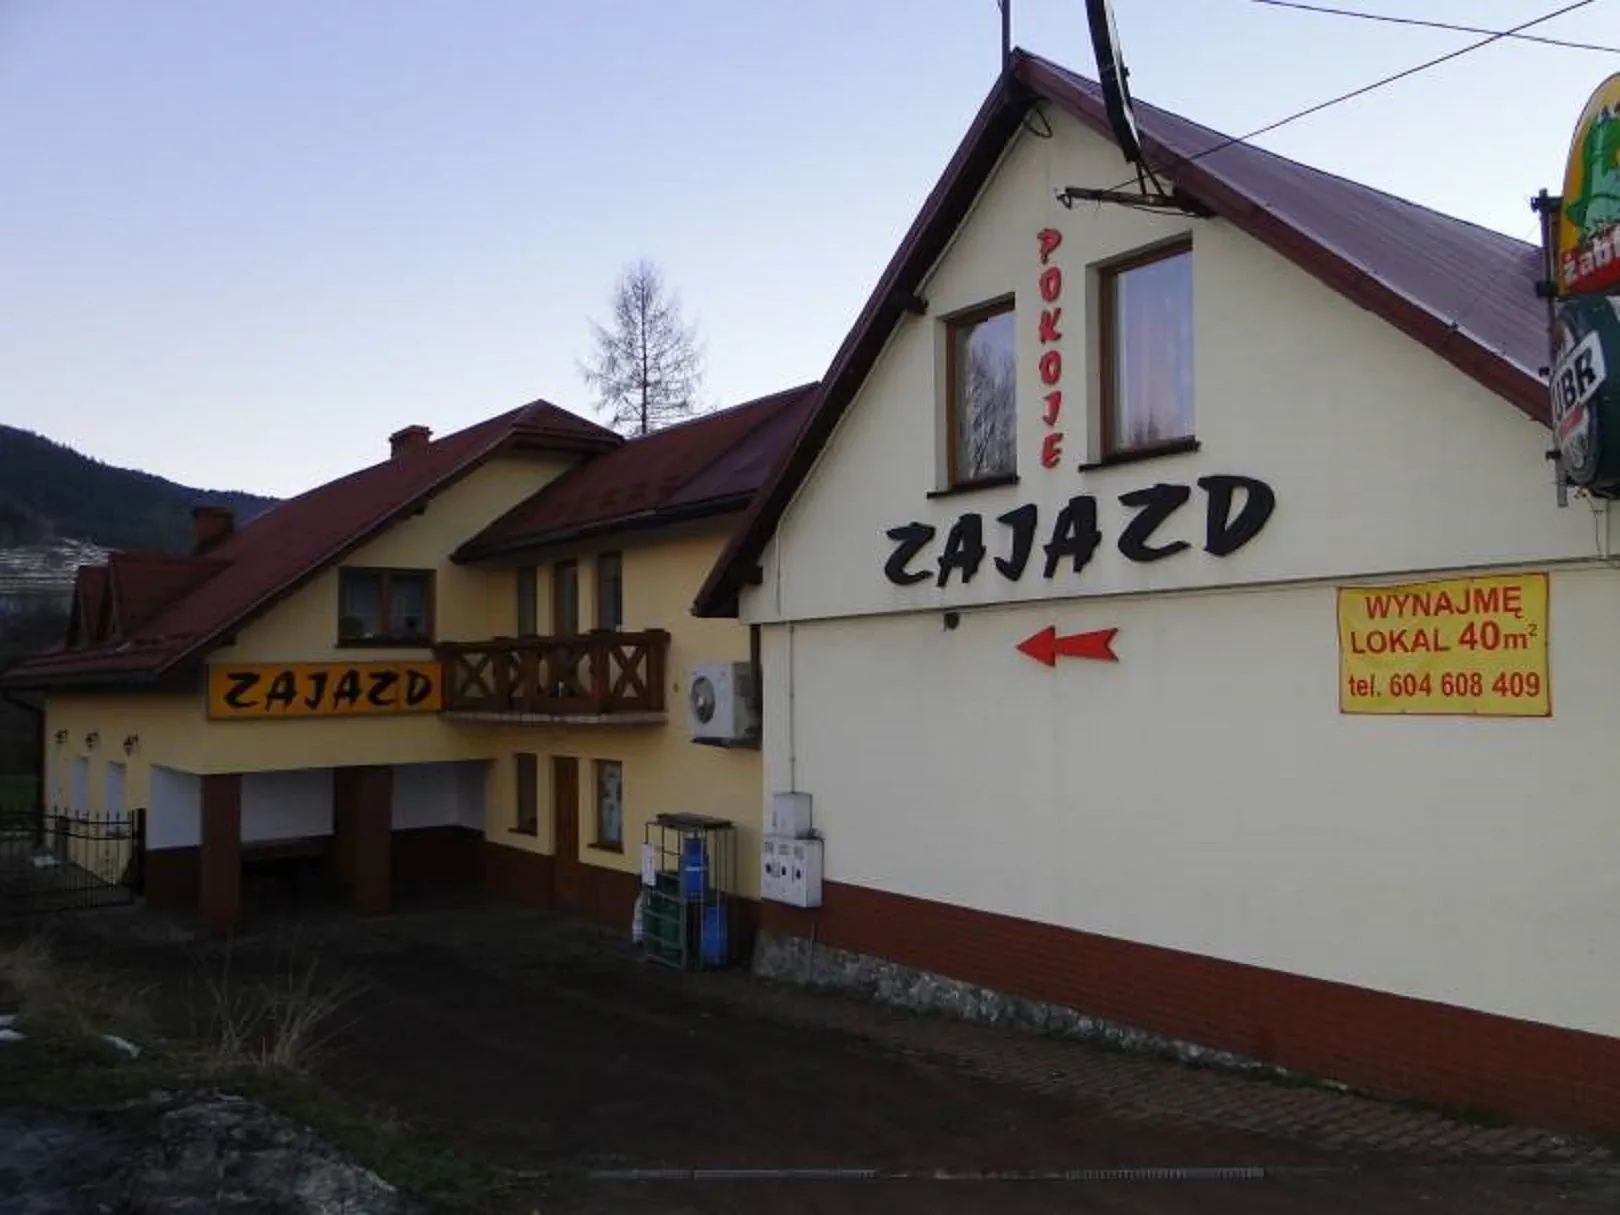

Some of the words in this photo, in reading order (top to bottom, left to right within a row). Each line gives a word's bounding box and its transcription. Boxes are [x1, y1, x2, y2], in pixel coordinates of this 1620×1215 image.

[1037, 227, 1063, 470] POKOJE
[1553, 347, 1596, 419] UBR
[884, 475, 1275, 587] ZAJAZD
[1365, 587, 1523, 619] WYNAJMĘ
[1350, 628, 1450, 654] LOKAL
[224, 668, 433, 712] ZAJAZD
[1348, 673, 1382, 697] tel.
[1390, 672, 1432, 697] 604
[1441, 672, 1483, 697] 608
[1492, 672, 1540, 697] 409
